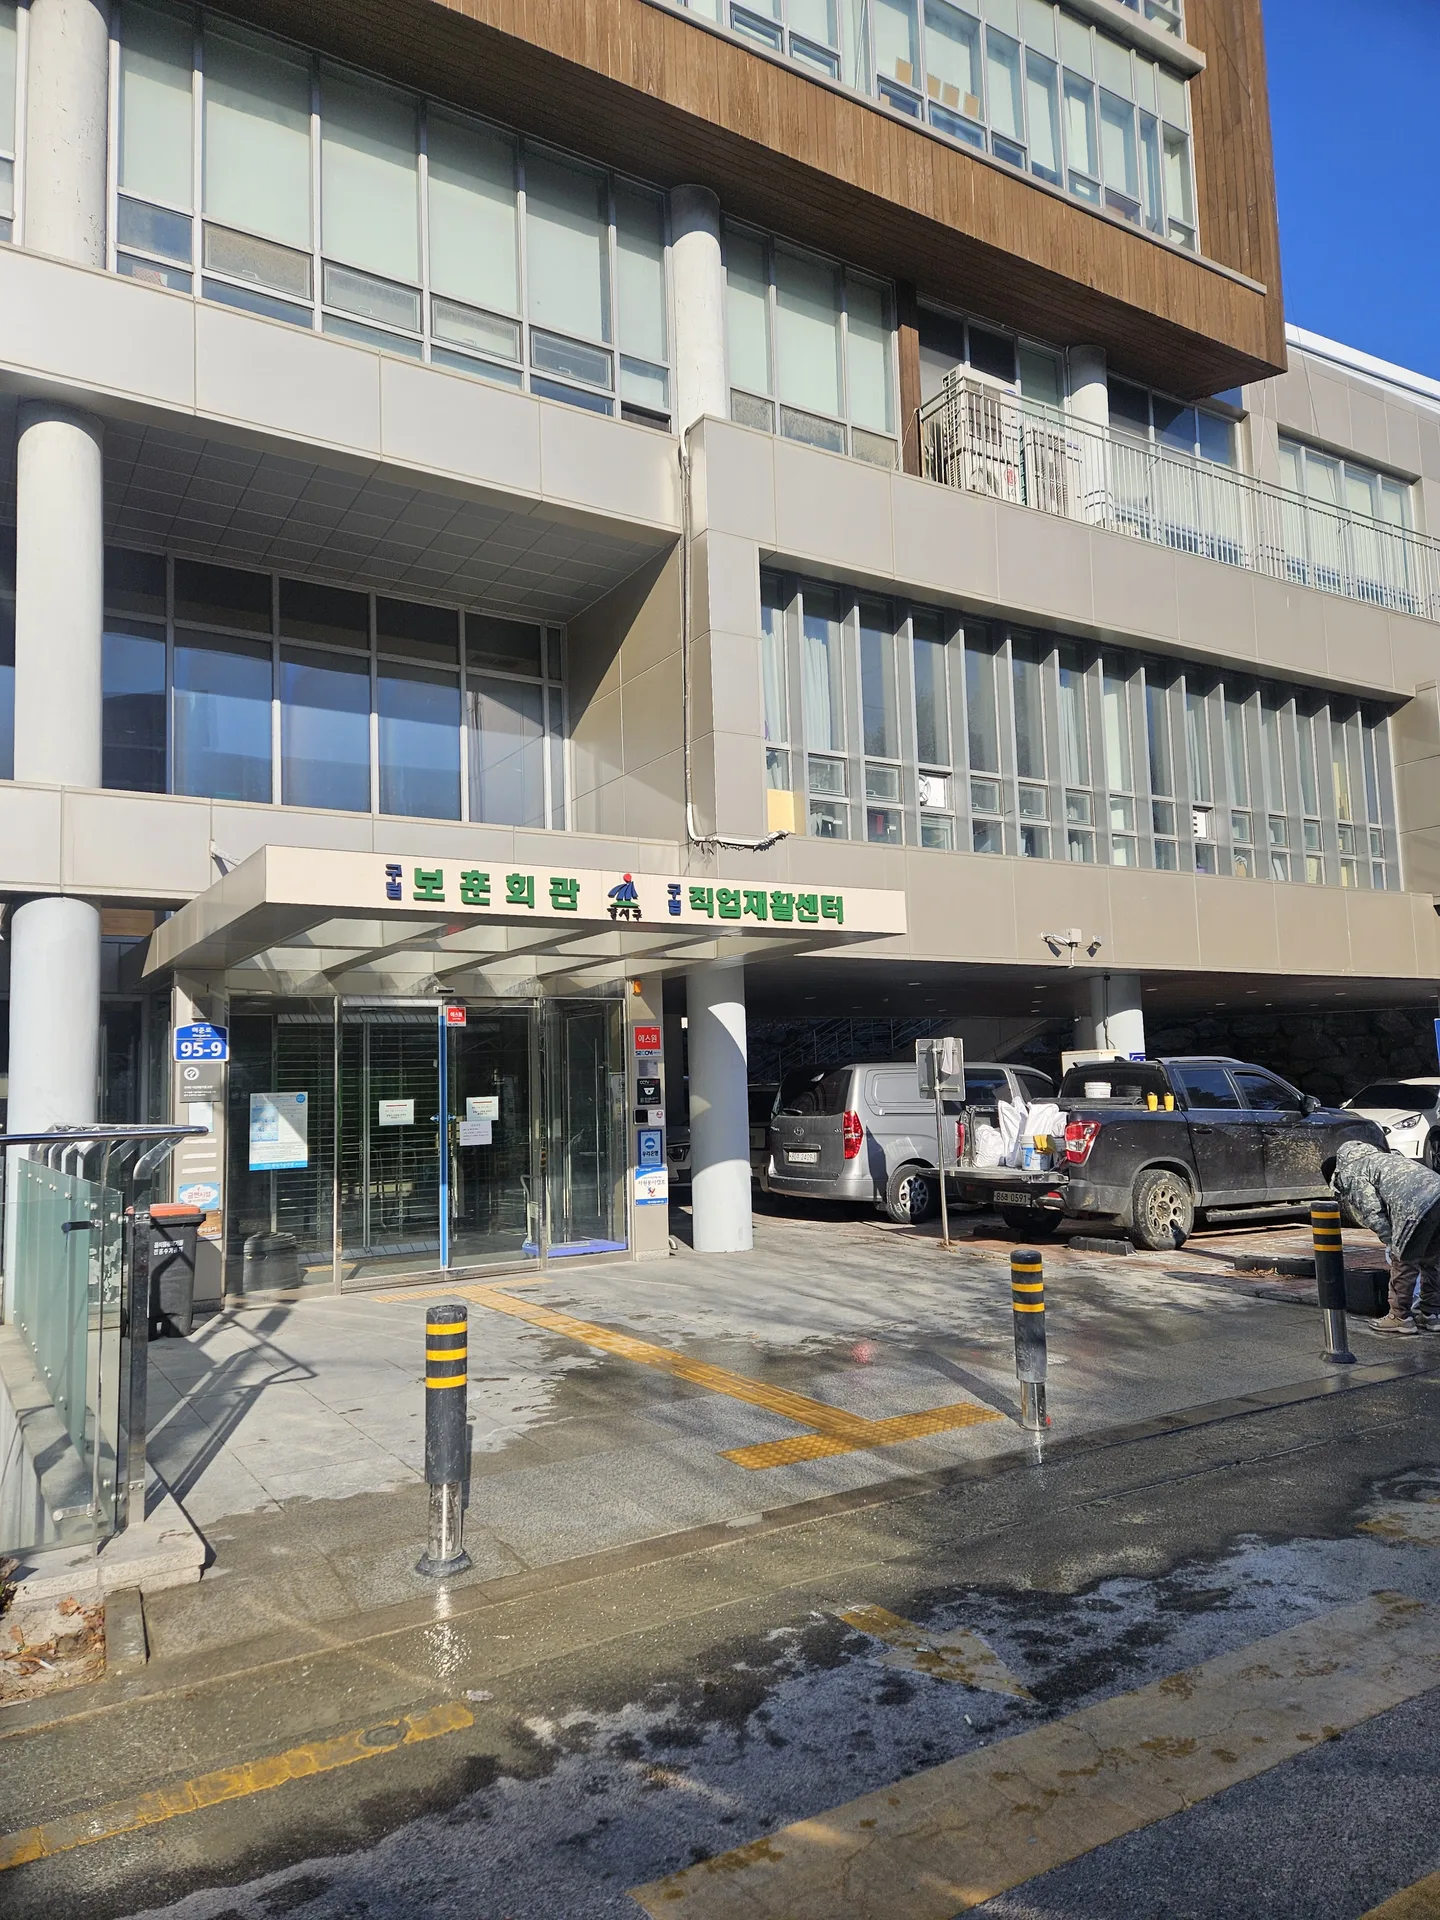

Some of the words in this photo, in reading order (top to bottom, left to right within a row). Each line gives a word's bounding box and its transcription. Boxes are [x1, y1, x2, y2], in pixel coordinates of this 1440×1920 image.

[385, 863, 402, 901] 구립
[413, 867, 580, 911] 보훈회관
[667, 883, 682, 916] 구립
[688, 886, 844, 924] 직업재활센터
[606, 907, 642, 922] 강서구
[637, 1034, 657, 1043] 에스원
[180, 1041, 222, 1057] 95-9
[187, 1191, 211, 1199] 금연시설
[1010, 1193, 1027, 1203] 0591
